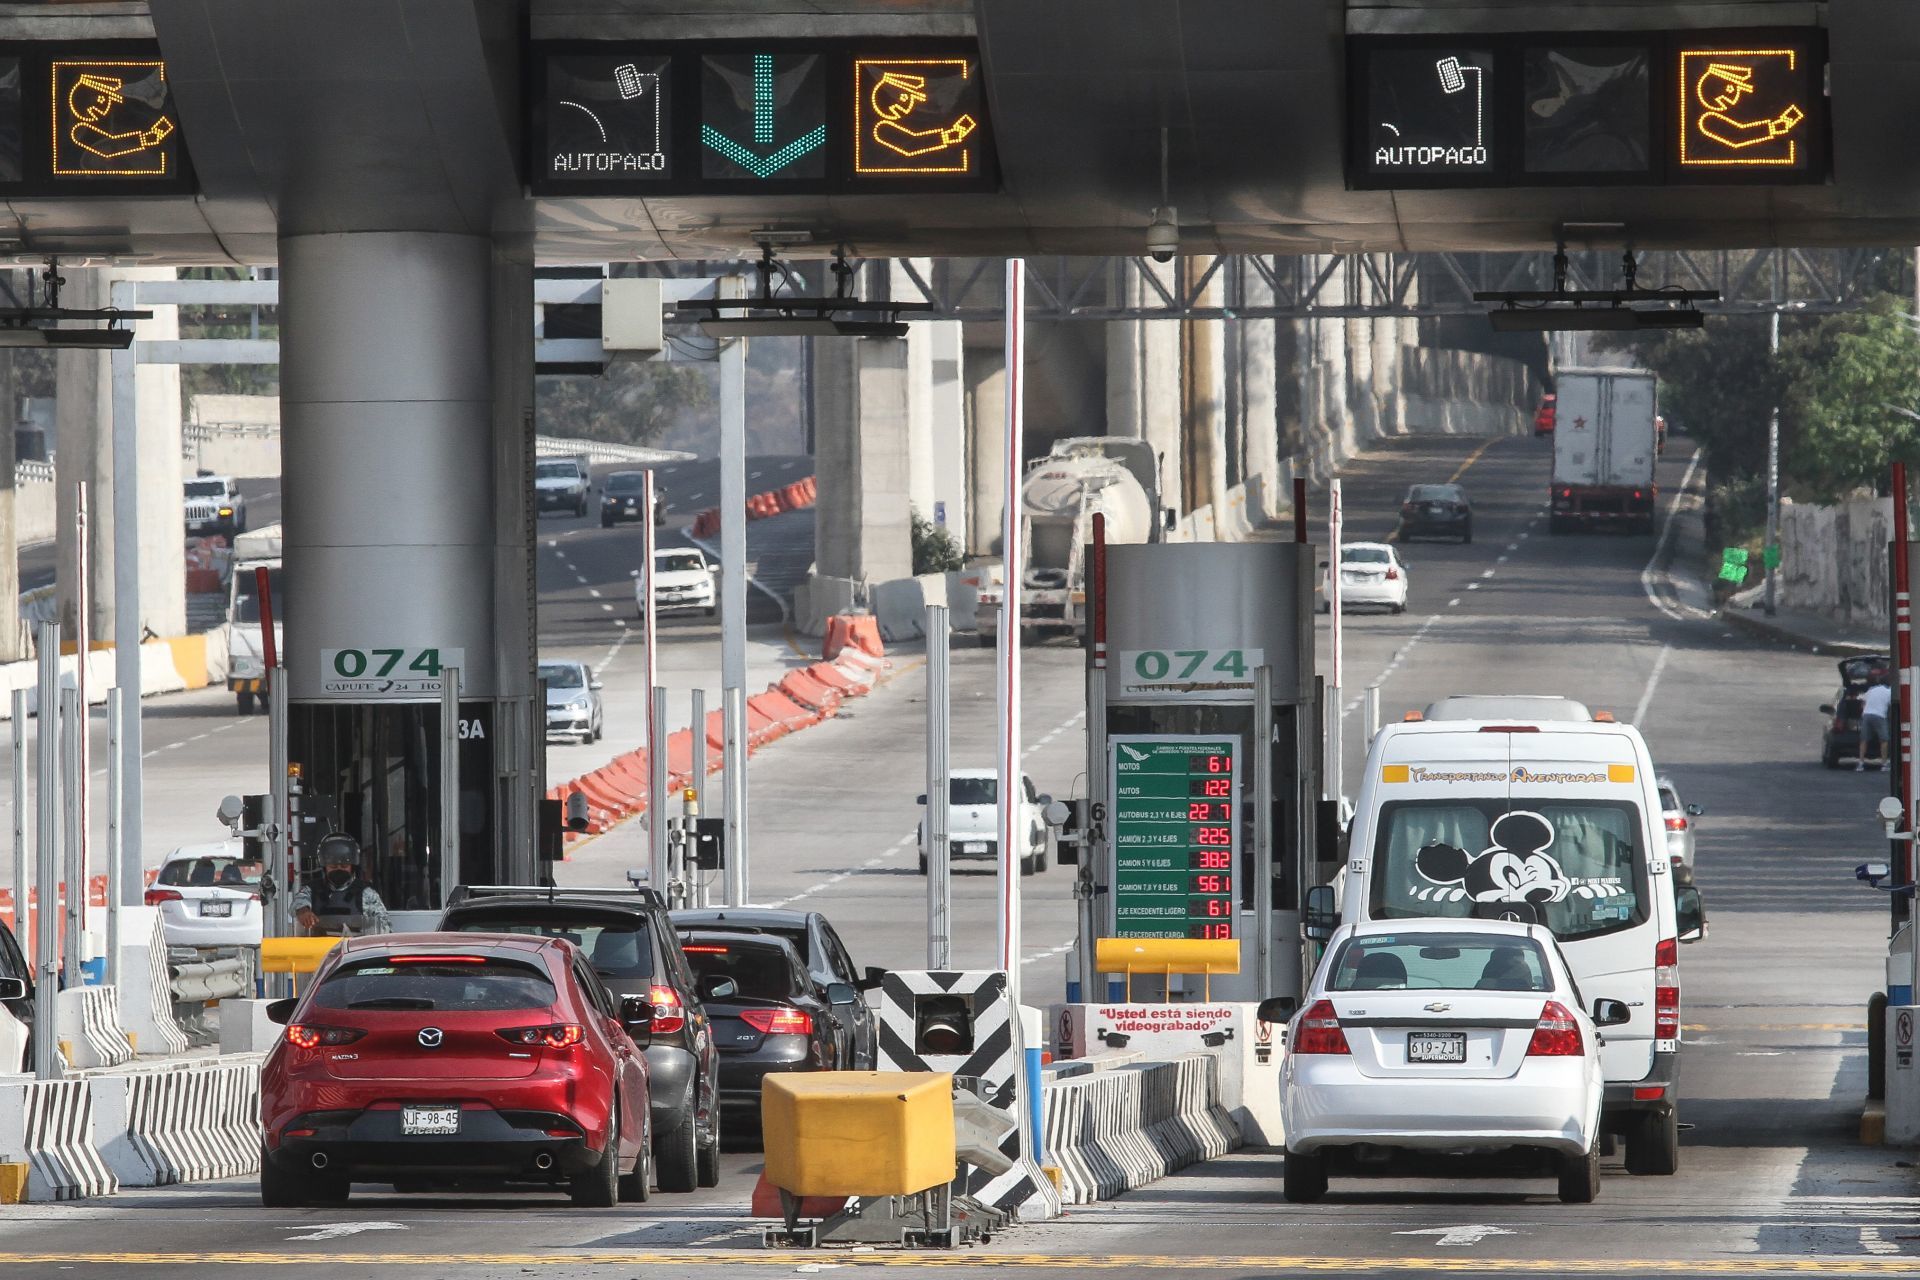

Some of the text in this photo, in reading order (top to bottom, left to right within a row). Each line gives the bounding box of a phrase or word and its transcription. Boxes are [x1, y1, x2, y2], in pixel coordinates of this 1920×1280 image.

[554, 153, 664, 171] AUTOPAGO
[1375, 146, 1486, 165] AUTOPAGO
[333, 648, 443, 678] 074
[1135, 650, 1249, 680] 074
[325, 682, 375, 691] CAPUFE
[420, 682, 463, 691] HOS
[1118, 756, 1231, 773] MOTOS 61
[1118, 780, 1231, 796] AUTOS 122
[1091, 802, 1106, 822] 6
[1118, 811, 1149, 819] AUTOBUS
[1159, 811, 1165, 819] Y
[1170, 811, 1187, 819] EJES
[1152, 835, 1157, 843] Y
[1157, 835, 1162, 843] 4
[1162, 835, 1178, 843] EJES
[1199, 827, 1230, 845] 225
[1142, 859, 1146, 867] 5
[1146, 859, 1152, 867] Y
[1156, 859, 1172, 867] EJES
[1199, 851, 1231, 868] 382
[1152, 883, 1157, 891] Y
[1158, 883, 1162, 891] 9
[1162, 883, 1178, 891] EJES
[1198, 875, 1230, 892] 561
[1118, 900, 1230, 916] EJE EXCEDENTE LIGERO 61
[1129, 931, 1163, 939] EXCEDENTE
[1164, 931, 1185, 939] CARGA
[1205, 924, 1230, 939] 113
[1150, 1008, 1182, 1019] está
[1186, 1008, 1232, 1020] siendo
[1411, 1041, 1463, 1056] 619-ZJT
[404, 1111, 459, 1125] NJF-98-45
[404, 1126, 457, 1135] Picacho
